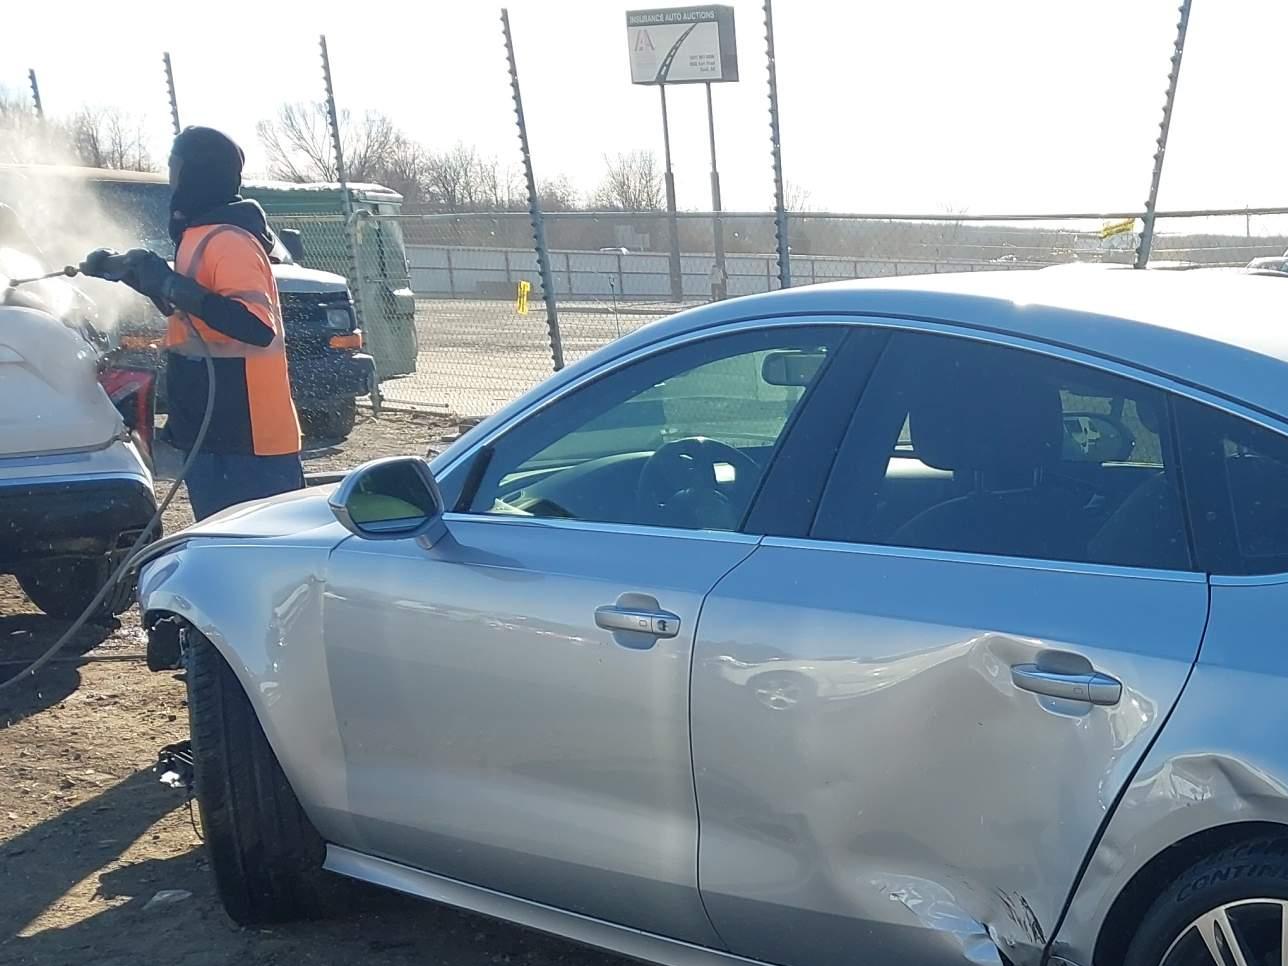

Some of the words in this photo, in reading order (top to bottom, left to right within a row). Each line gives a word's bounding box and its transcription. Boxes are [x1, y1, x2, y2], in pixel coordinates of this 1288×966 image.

[629, 15, 664, 24] INSURANCE
[665, 13, 682, 21] AUTO
[683, 10, 715, 19] AUCTIONS
